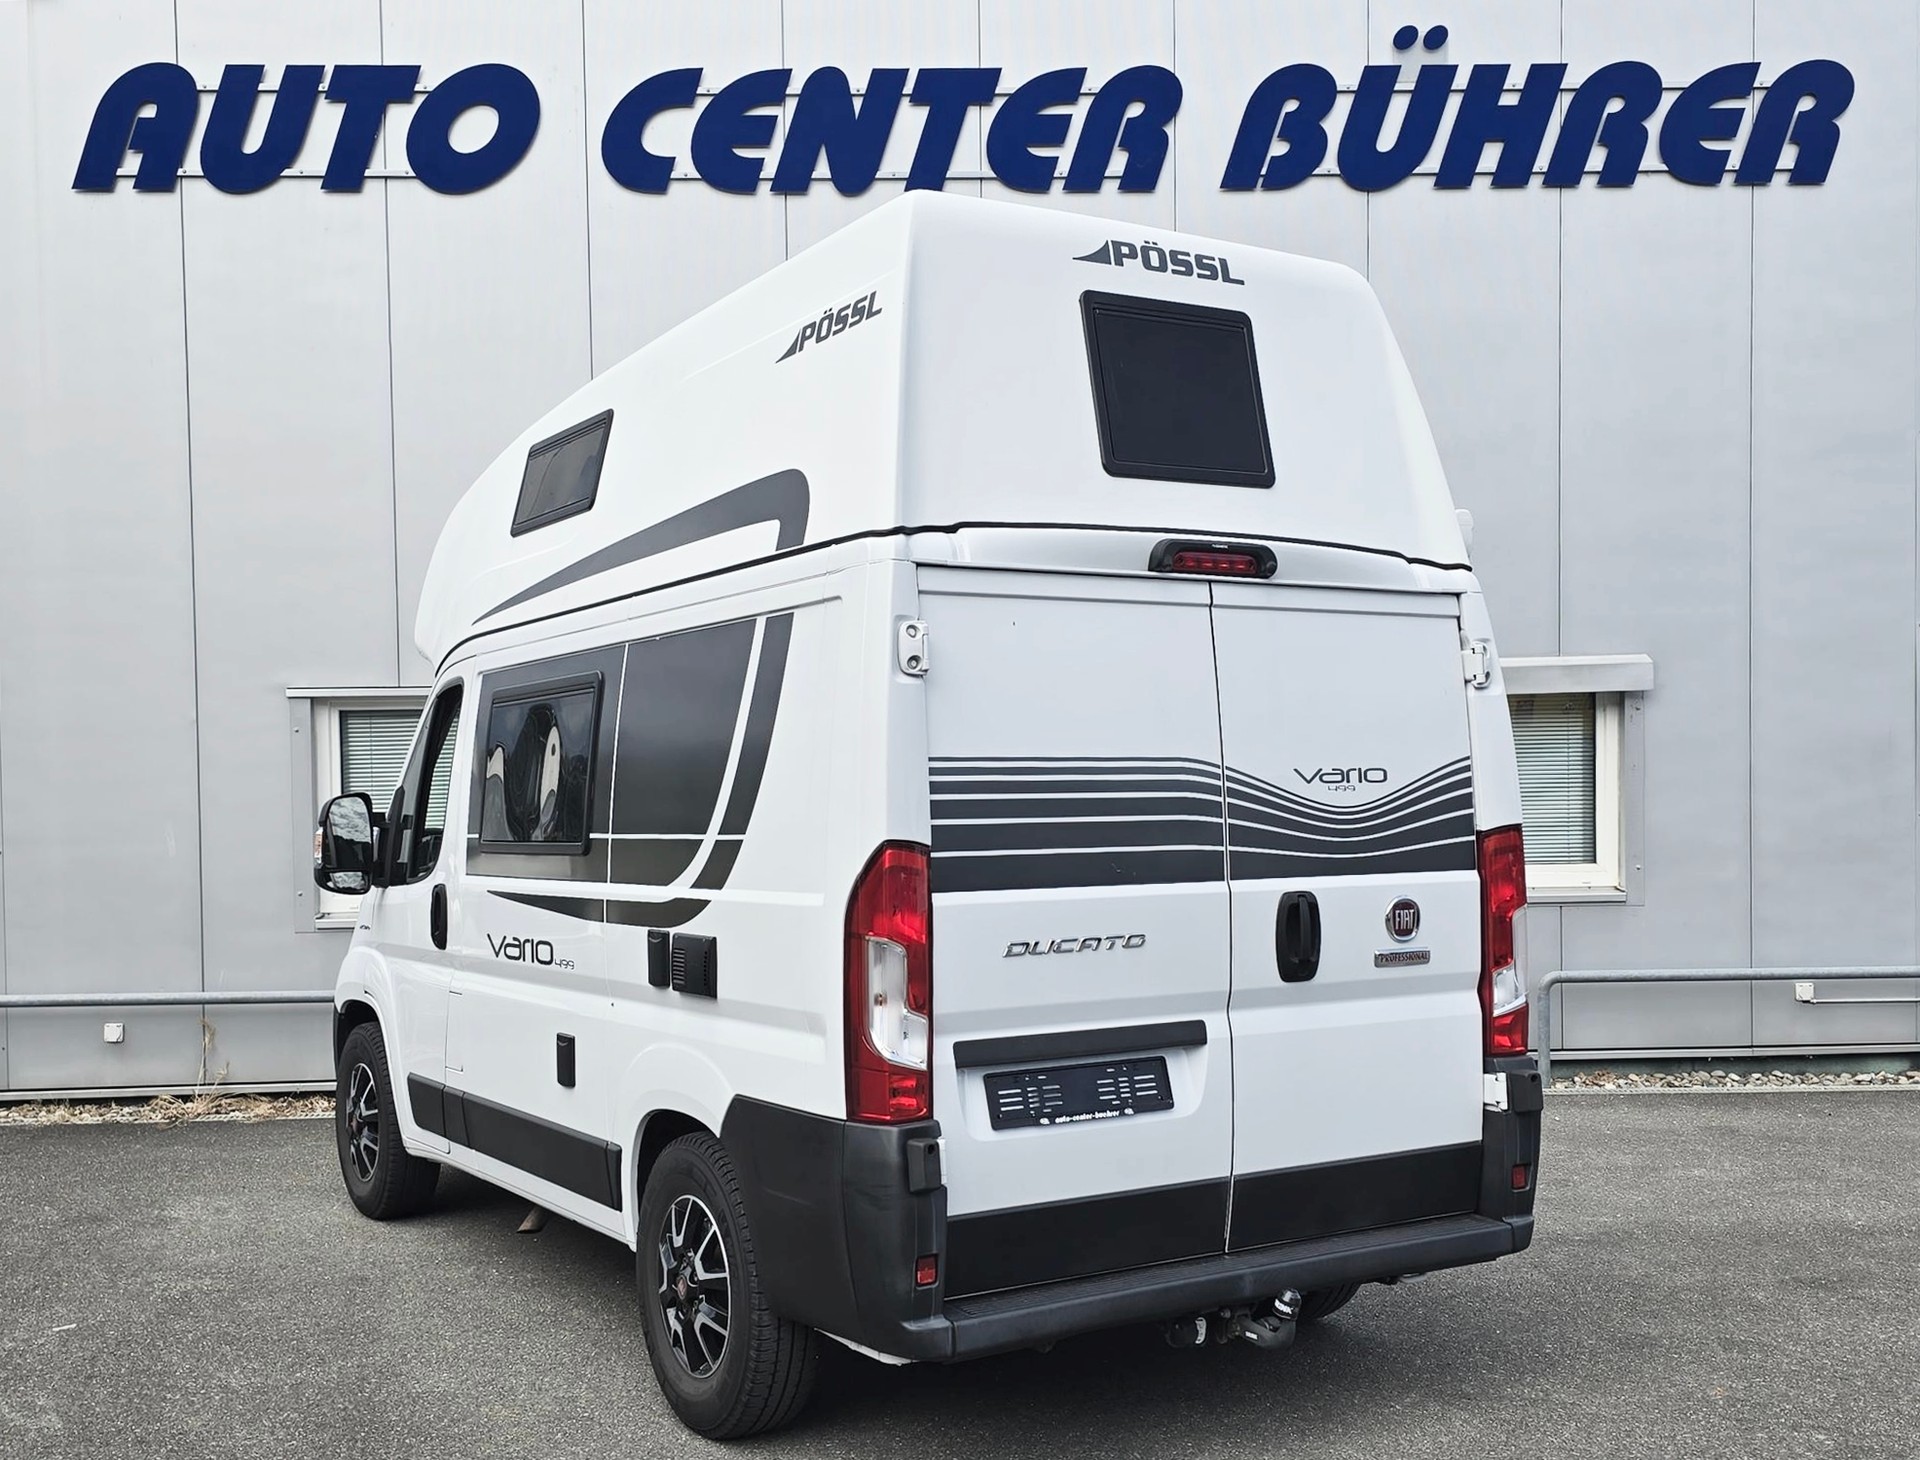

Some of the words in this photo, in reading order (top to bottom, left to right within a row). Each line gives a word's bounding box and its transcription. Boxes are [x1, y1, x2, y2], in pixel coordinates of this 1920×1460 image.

[72, 62, 541, 195] AUTO
[601, 65, 1184, 197] CENTER
[1219, 25, 1855, 192] BÜHRER
[1109, 239, 1245, 286] PÖSSL
[797, 290, 883, 354] PÖSSL
[1327, 784, 1356, 792] 499
[1395, 909, 1415, 930] FIAT
[1002, 933, 1147, 959] DUCATO
[554, 959, 575, 970] 499
